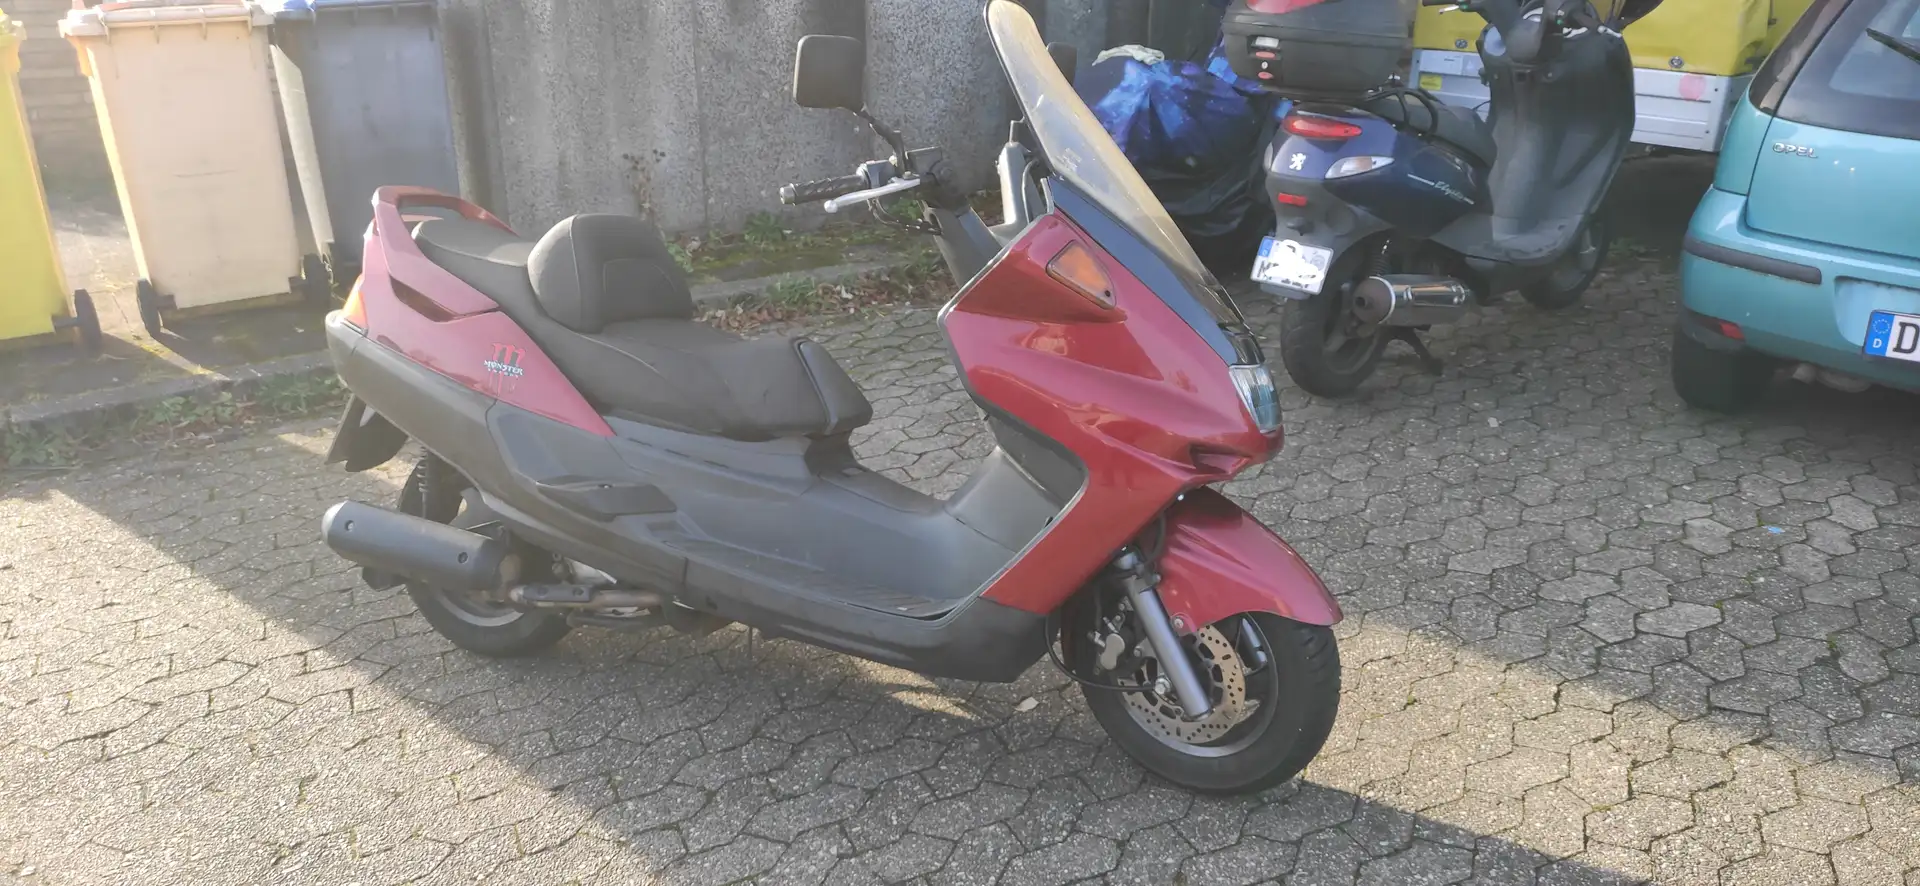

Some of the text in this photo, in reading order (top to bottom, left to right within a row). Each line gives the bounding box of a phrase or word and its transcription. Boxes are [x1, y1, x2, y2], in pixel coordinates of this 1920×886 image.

[1773, 142, 1819, 159] OPEL
[1872, 338, 1882, 348] D
[1892, 321, 1920, 354] D
[483, 359, 523, 376] MONSTER
